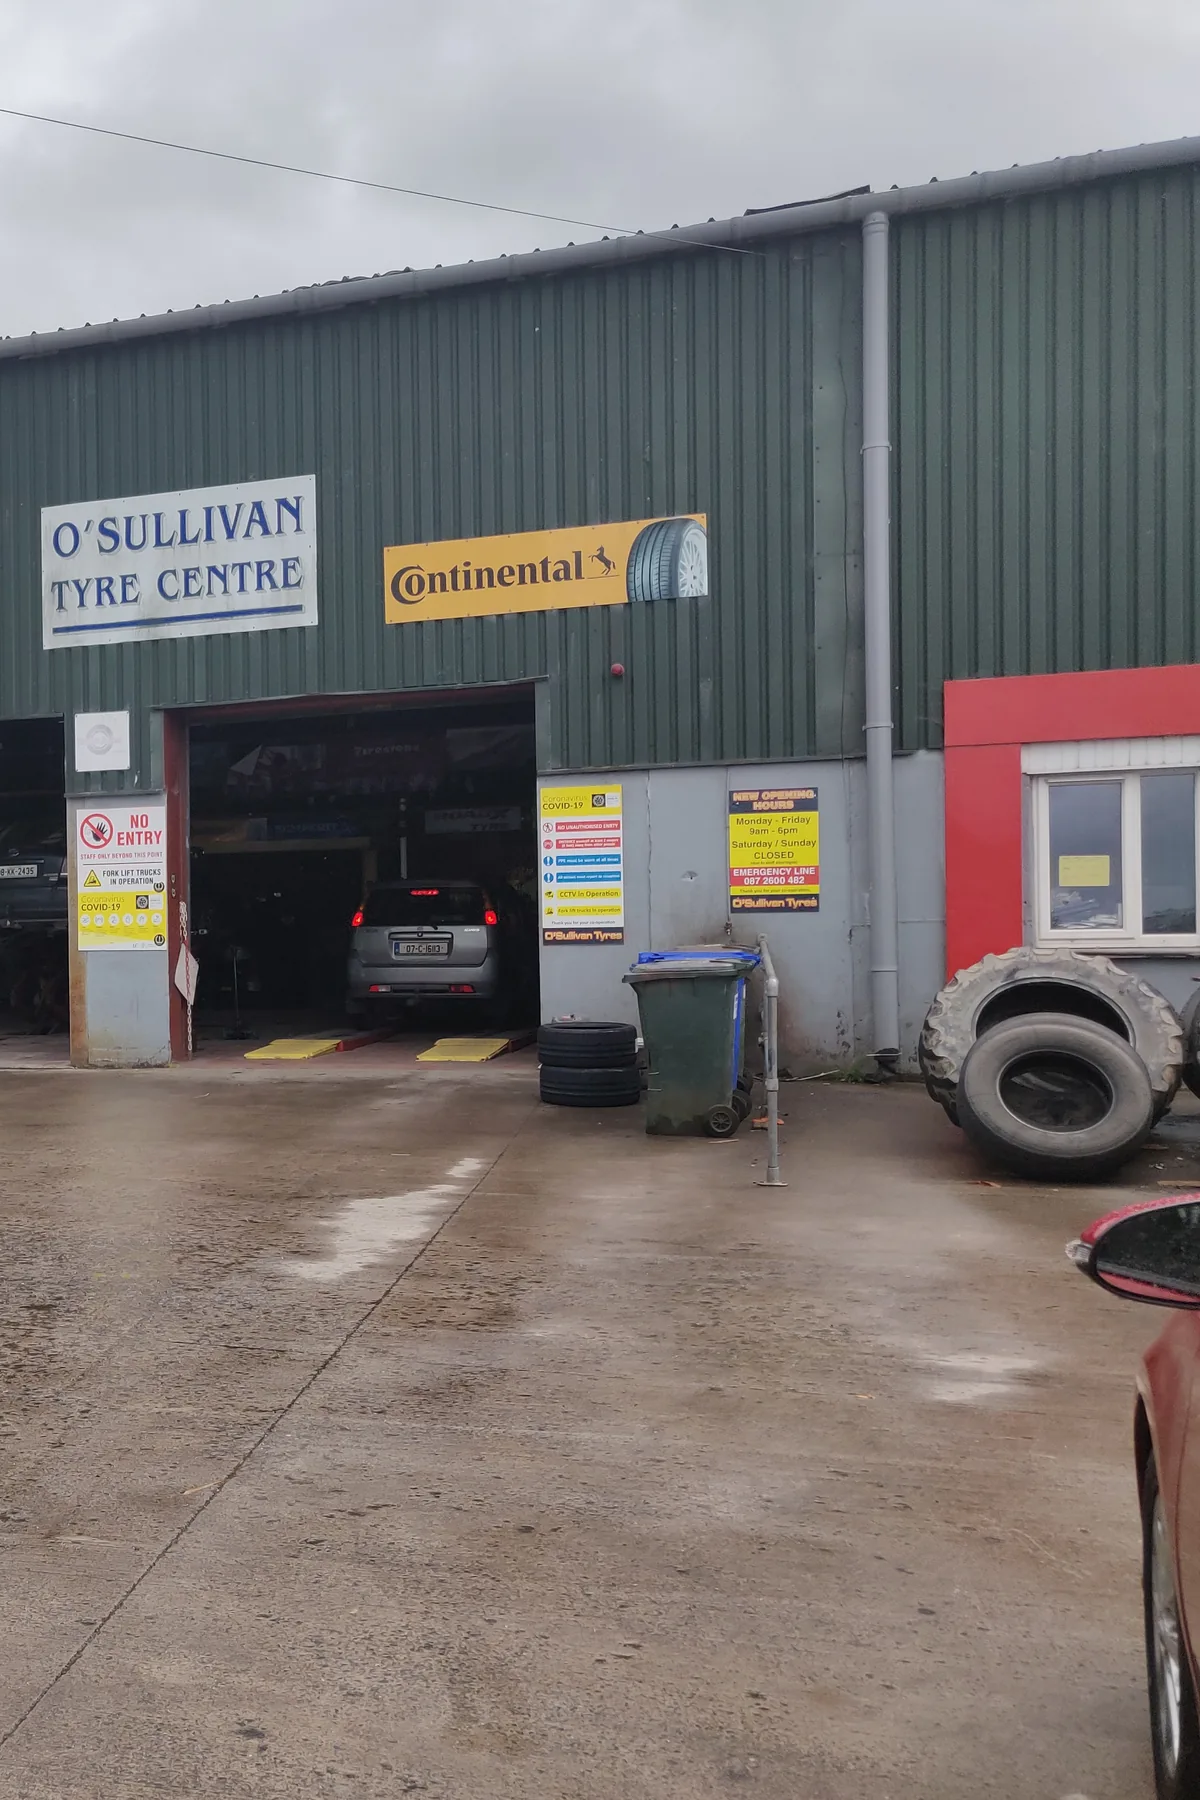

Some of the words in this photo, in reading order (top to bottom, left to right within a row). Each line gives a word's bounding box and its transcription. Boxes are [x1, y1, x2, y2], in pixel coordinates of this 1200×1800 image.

[52, 496, 306, 558] O'SULLIVAN
[390, 551, 583, 605] Continental
[51, 573, 141, 612] TYRE
[157, 556, 304, 601] CENTRE
[542, 794, 587, 803] Coronavirus
[732, 792, 759, 802] NEW
[761, 790, 815, 800] OPENING
[542, 802, 584, 810] COVID-19
[752, 800, 794, 810] HOURS
[130, 814, 149, 829] NO
[736, 817, 773, 826] Monday
[781, 816, 811, 825] Friday
[777, 827, 798, 836] 6pm
[117, 830, 162, 846] ENTRY
[732, 841, 773, 849] Saturday
[781, 839, 817, 848] Sunday
[753, 851, 794, 860] CLOSED
[120, 869, 134, 877] LIFT
[733, 868, 792, 877] EMERGENCY
[794, 867, 816, 875] LINE
[118, 877, 154, 885] OPERATION
[743, 877, 760, 885] 087
[762, 876, 786, 885] 2600
[787, 876, 805, 884] 482
[81, 894, 125, 903] Coronavirus
[585, 890, 619, 898] Operation
[732, 898, 785, 908] O'Sullivan
[785, 897, 817, 909] Tyres
[544, 931, 593, 940] O'Sullivan
[593, 930, 622, 942] Tyres
